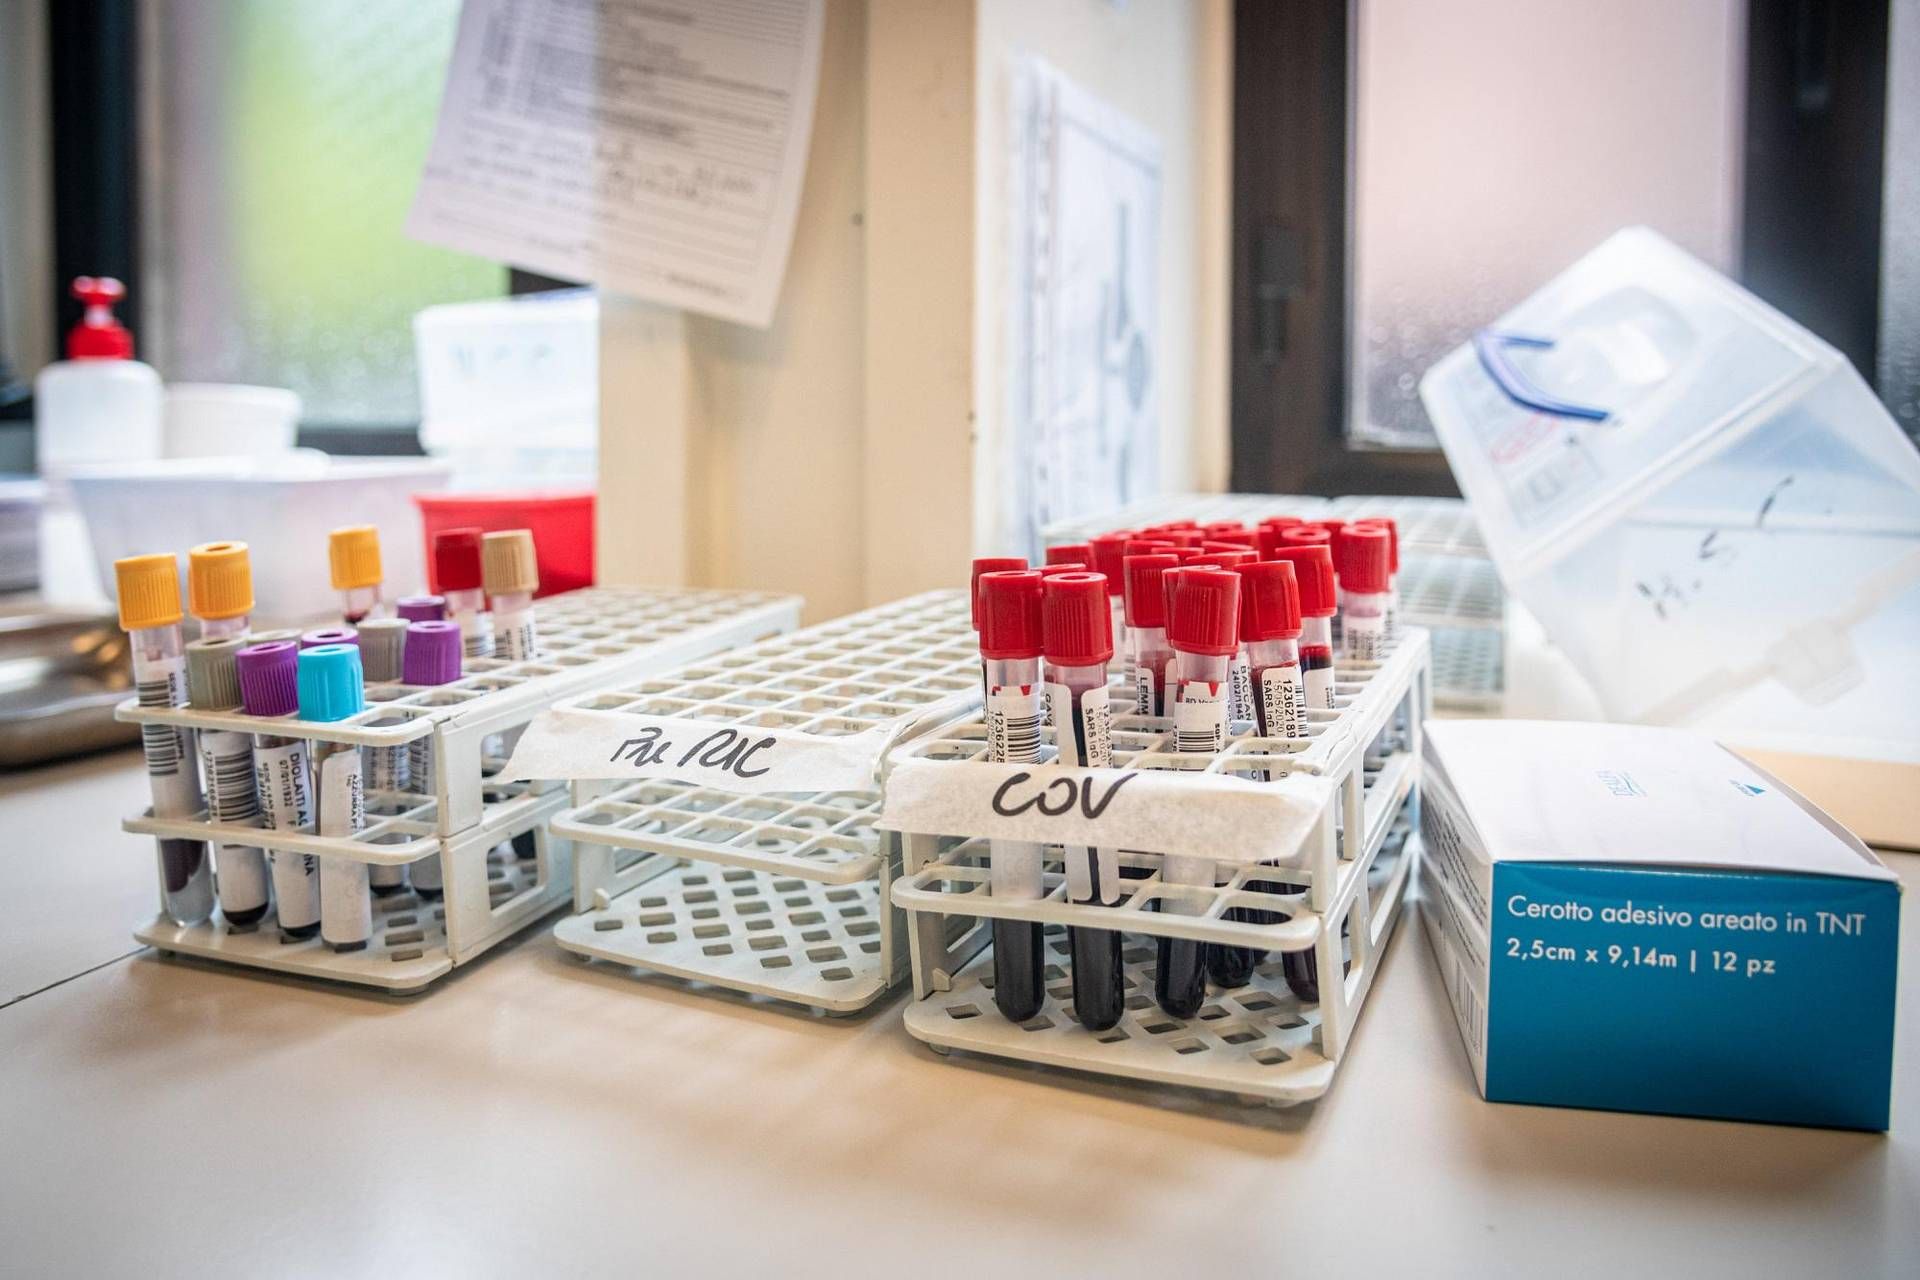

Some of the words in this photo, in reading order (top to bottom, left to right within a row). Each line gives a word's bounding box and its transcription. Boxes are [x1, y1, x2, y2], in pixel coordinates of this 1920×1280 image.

[1263, 680, 1273, 708] SARS
[1086, 708, 1097, 738] SARS
[1507, 895, 1593, 922] Cerotto
[1600, 901, 1692, 928] adesivo
[1700, 909, 1777, 932] areato
[1786, 911, 1807, 933] in
[1816, 912, 1866, 936] TNT
[1506, 938, 1576, 961] 2,5cm
[1585, 948, 1598, 963] x
[1607, 944, 1678, 969] 9,14m
[1712, 951, 1737, 972] 12
[1747, 960, 1776, 978] pz
